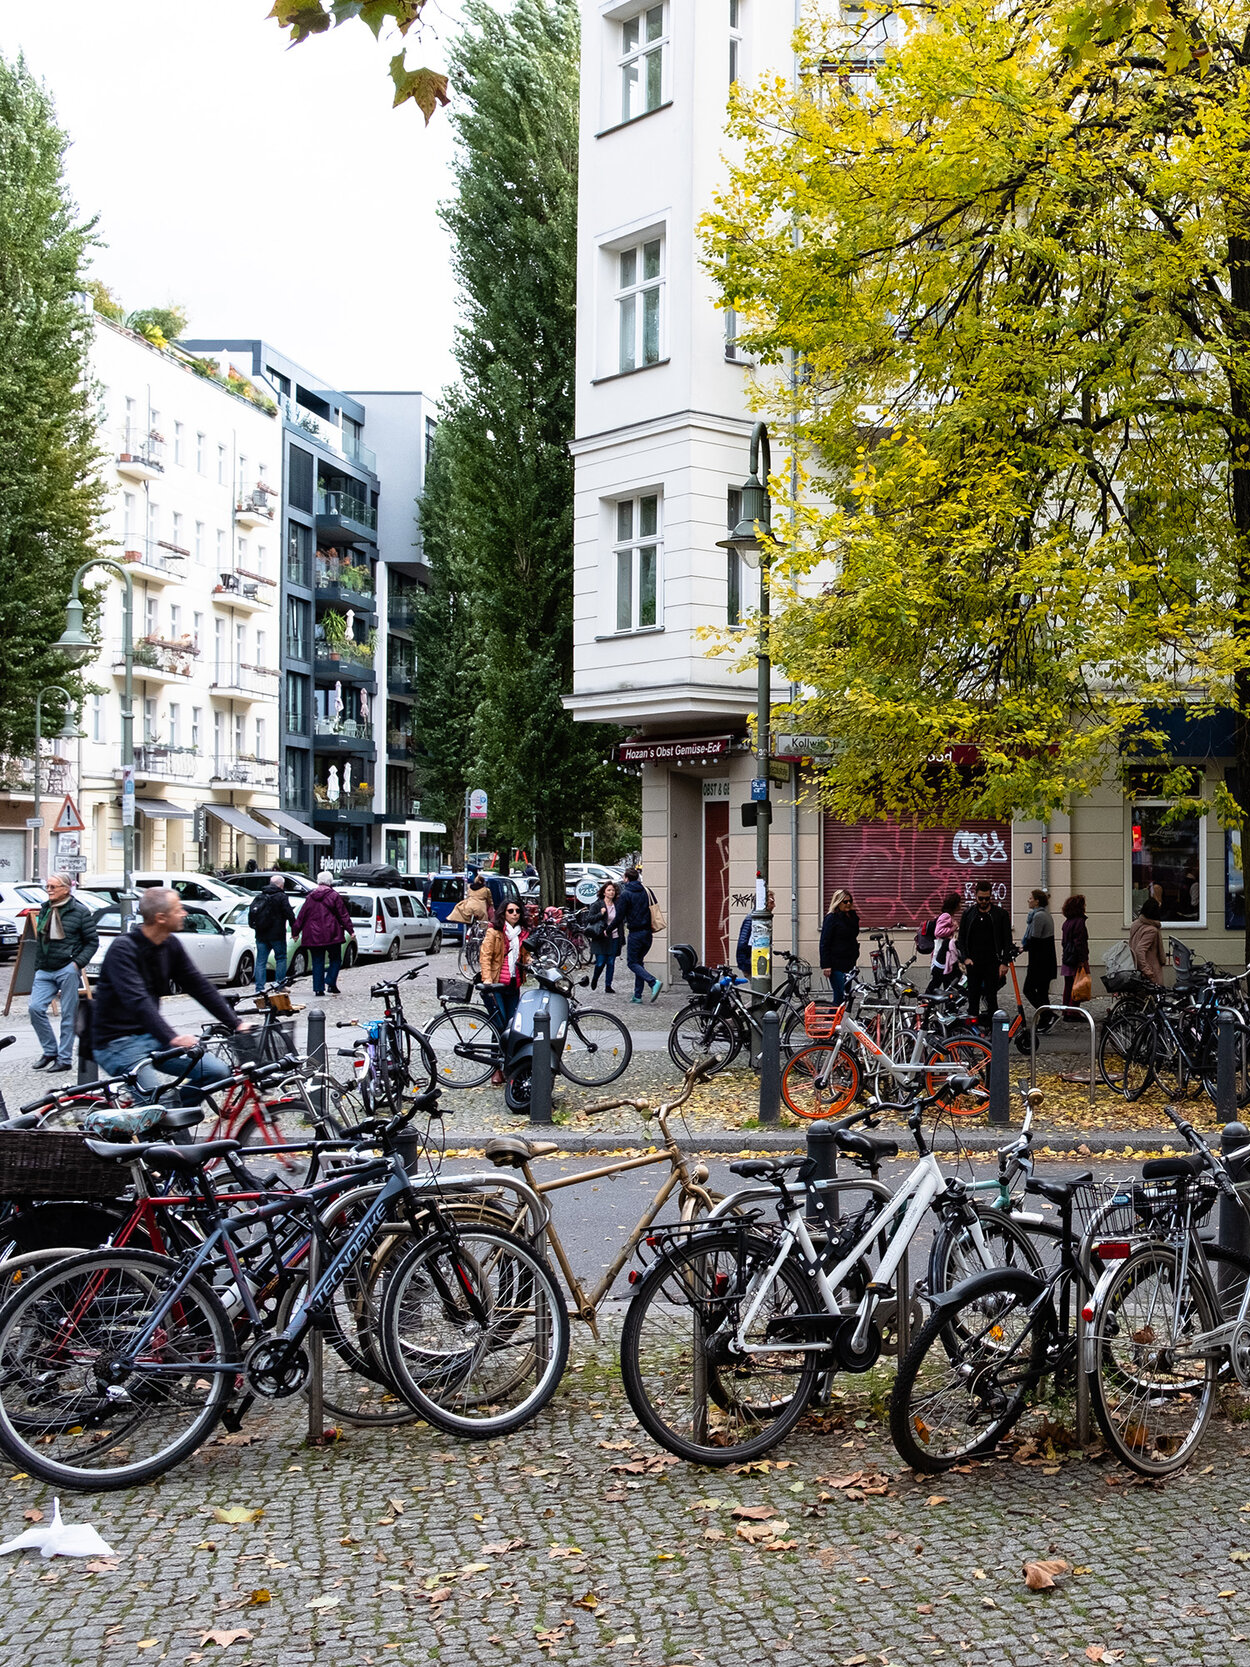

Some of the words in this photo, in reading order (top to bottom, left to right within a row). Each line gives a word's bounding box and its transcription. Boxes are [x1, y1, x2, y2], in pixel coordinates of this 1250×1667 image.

[656, 746, 674, 757] Obst
[675, 742, 722, 756] Gemüse-Eck
[703, 783, 717, 796] OBST
[718, 783, 723, 796] &
[314, 1202, 387, 1305] TECNOBIKE
